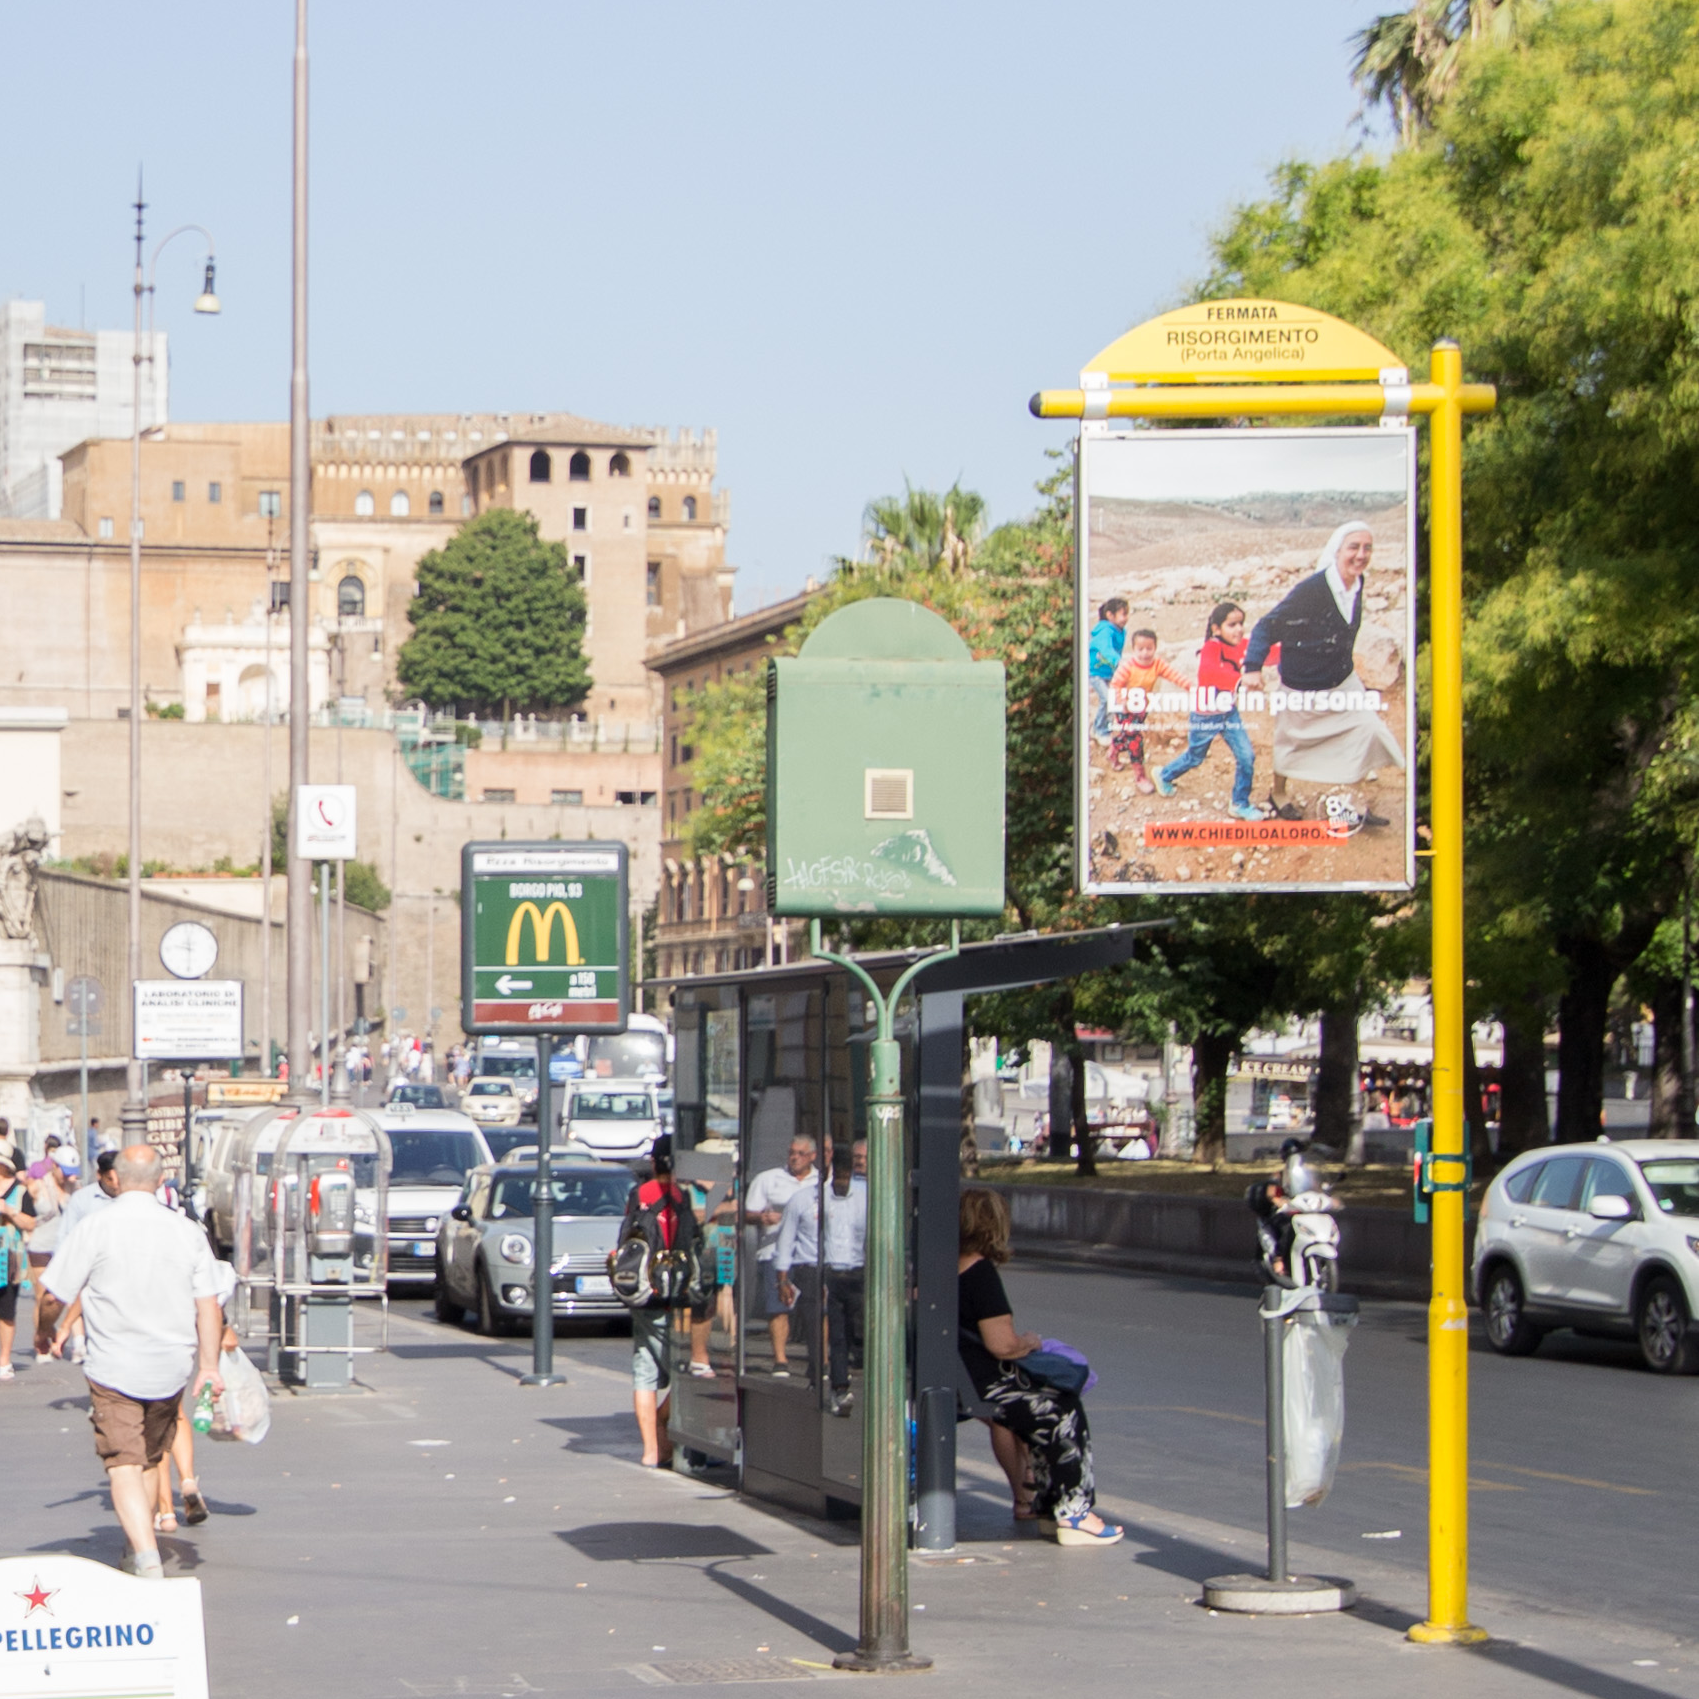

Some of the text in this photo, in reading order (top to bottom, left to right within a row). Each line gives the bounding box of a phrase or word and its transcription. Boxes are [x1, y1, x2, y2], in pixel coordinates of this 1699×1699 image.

[1207, 307, 1278, 320] FERMATA
[1167, 329, 1319, 345] RISORGIMENTO
[1181, 346, 1305, 364] (Porta Angelica)
[1238, 686, 1265, 712] in
[1269, 690, 1389, 715] persona.
[1152, 827, 1340, 840] WWW.CHIEDILOALORO.
[509, 883, 545, 898] BORGO
[569, 973, 577, 986] a
[144, 990, 235, 998] LABORATORIO DI
[142, 999, 184, 1007] ANALISI
[1242, 1061, 1311, 1076] ICE CREAM
